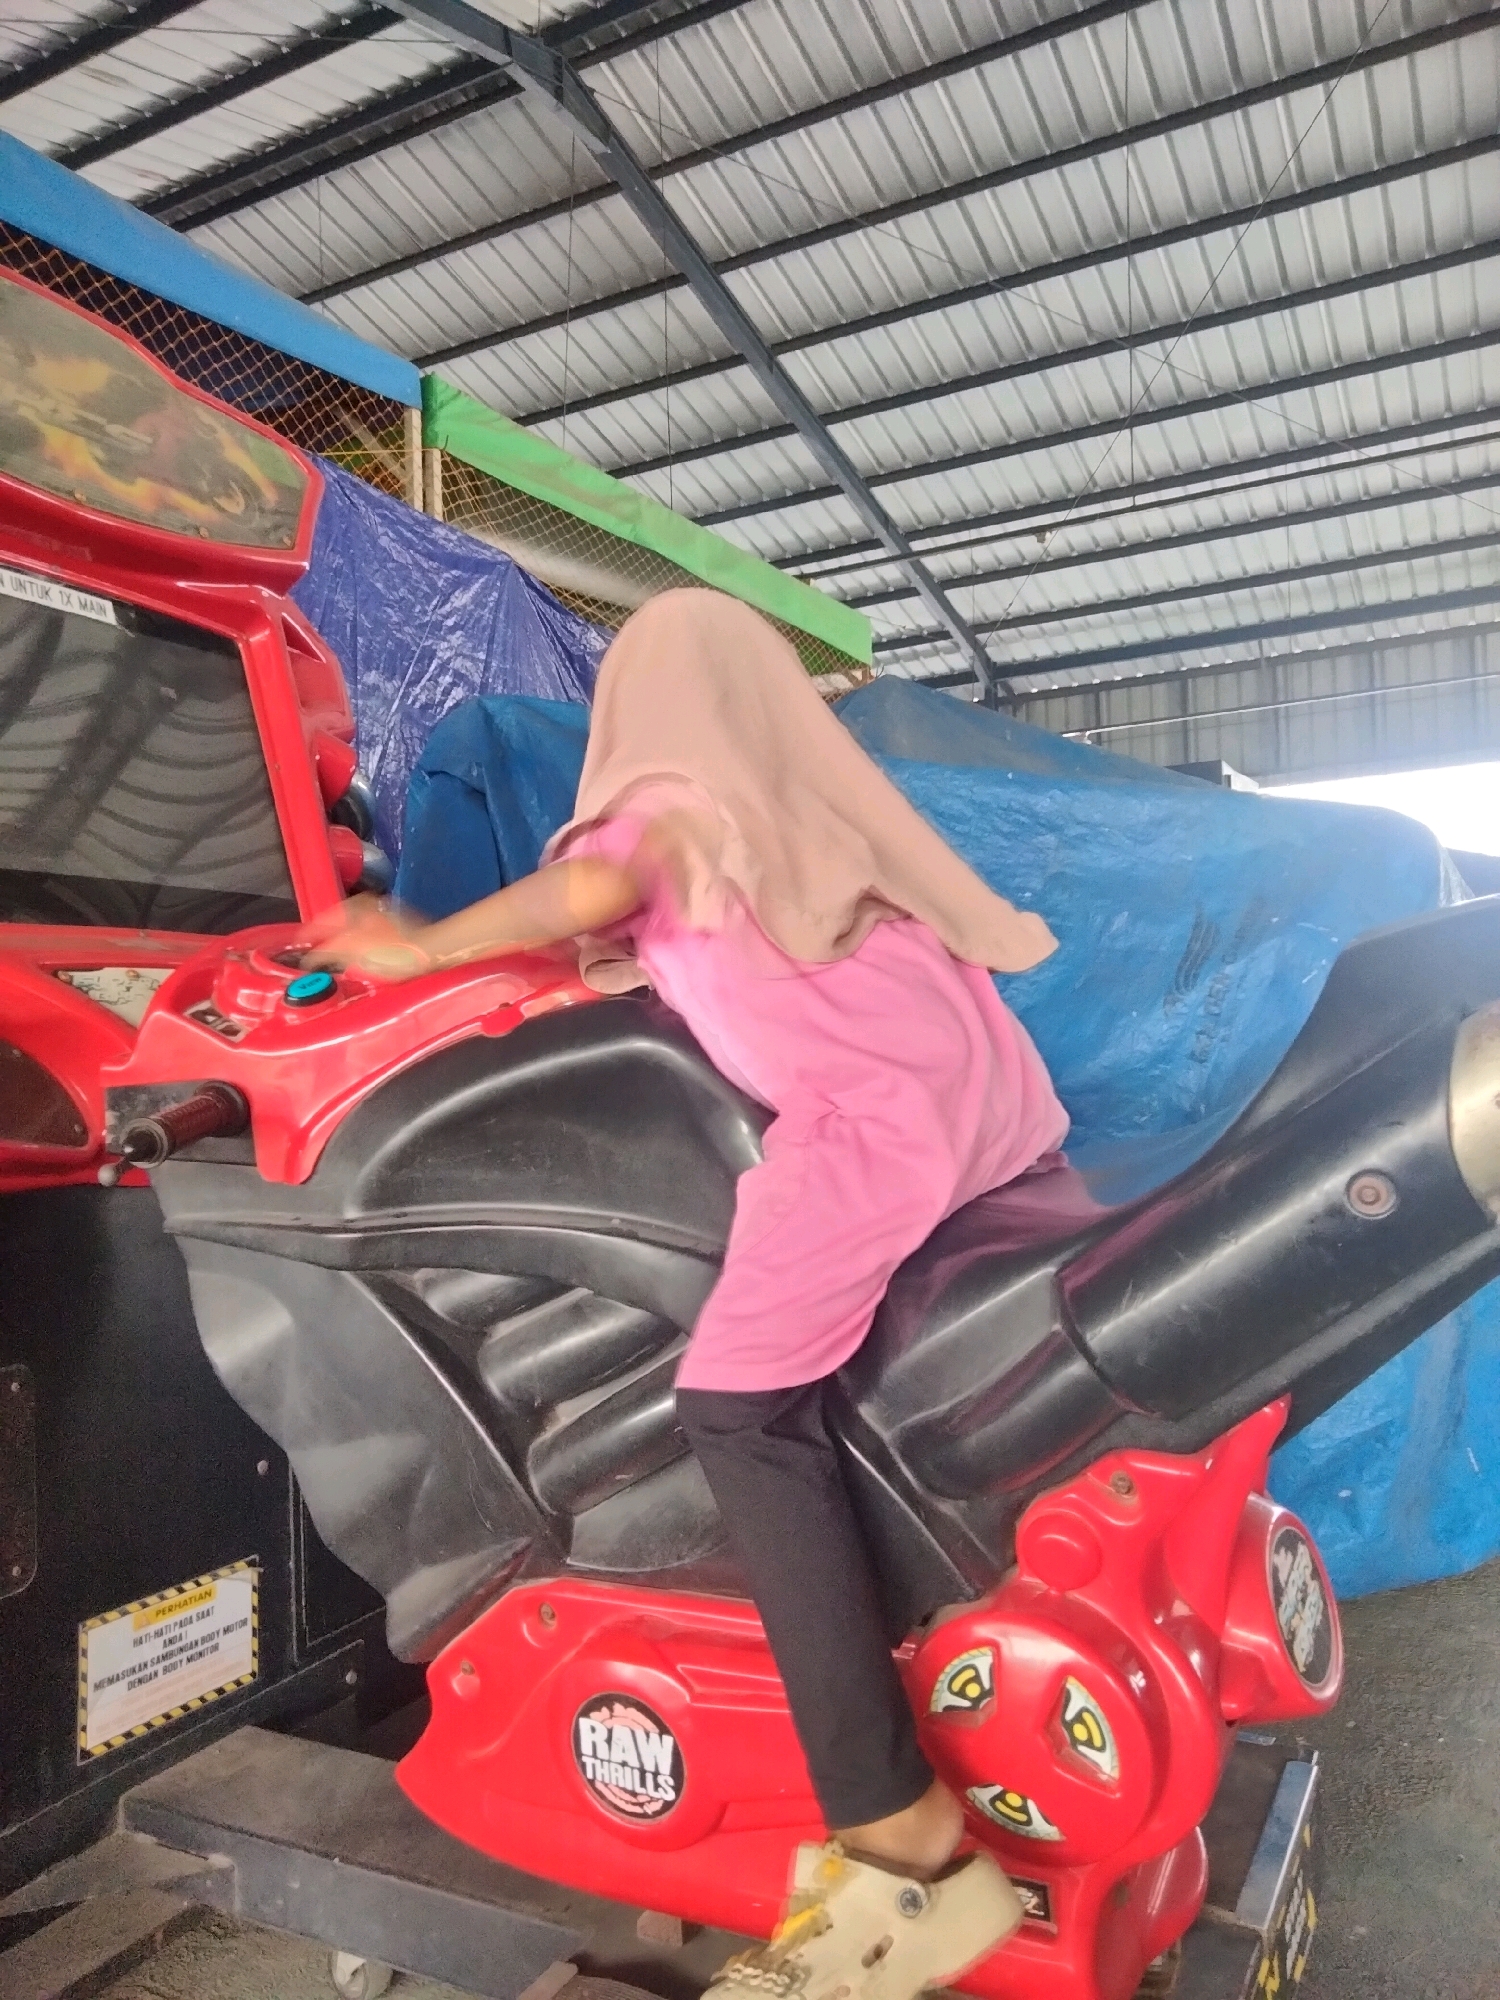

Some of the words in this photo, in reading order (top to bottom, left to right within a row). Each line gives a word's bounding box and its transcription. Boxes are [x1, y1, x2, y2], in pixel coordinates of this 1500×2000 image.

[10, 575, 52, 602] UNTUK
[59, 590, 73, 608] 1X
[78, 596, 107, 617] MAIN
[155, 1588, 212, 1618] PERHATIAN
[133, 1624, 172, 1648] HATI-HATI
[173, 1615, 193, 1634] PADA
[195, 1605, 215, 1622] SAAT
[162, 1632, 183, 1650] ANDA
[93, 1661, 149, 1693] MEMASUKAN
[150, 1639, 199, 1668] SAMBUNGAN
[200, 1629, 221, 1646] BODY
[222, 1617, 248, 1637] MOTOR
[127, 1669, 159, 1692] DENGAN
[162, 1658, 184, 1676] BODY
[185, 1642, 220, 1666] MONITOR
[579, 1717, 674, 1776] RAW
[581, 1755, 676, 1801] THRILLS
